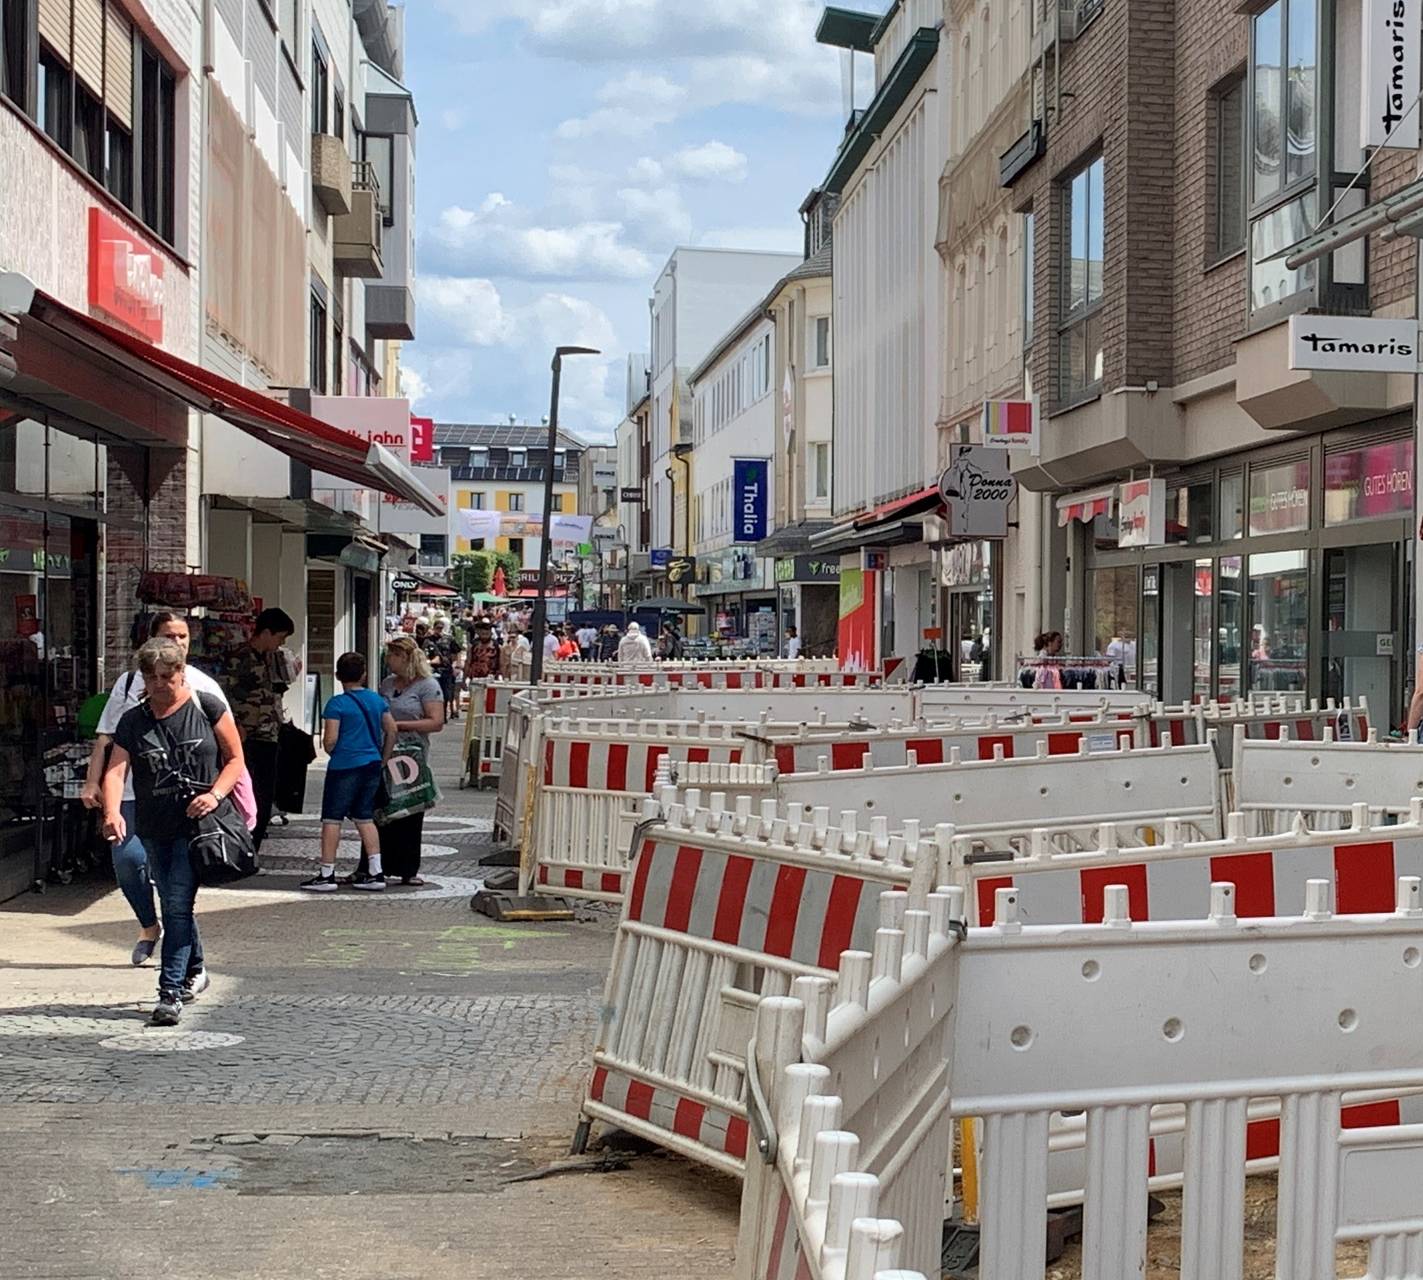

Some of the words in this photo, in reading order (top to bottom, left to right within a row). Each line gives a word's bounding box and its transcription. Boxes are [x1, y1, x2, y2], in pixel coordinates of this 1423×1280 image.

[968, 473, 1013, 487] Donna
[1363, 474, 1386, 498] GUTES
[1387, 468, 1412, 494] HÖREN
[973, 488, 1009, 500] 2000
[743, 482, 758, 535] Thalia
[553, 572, 577, 583] PIZZ
[392, 580, 418, 590] ONLY
